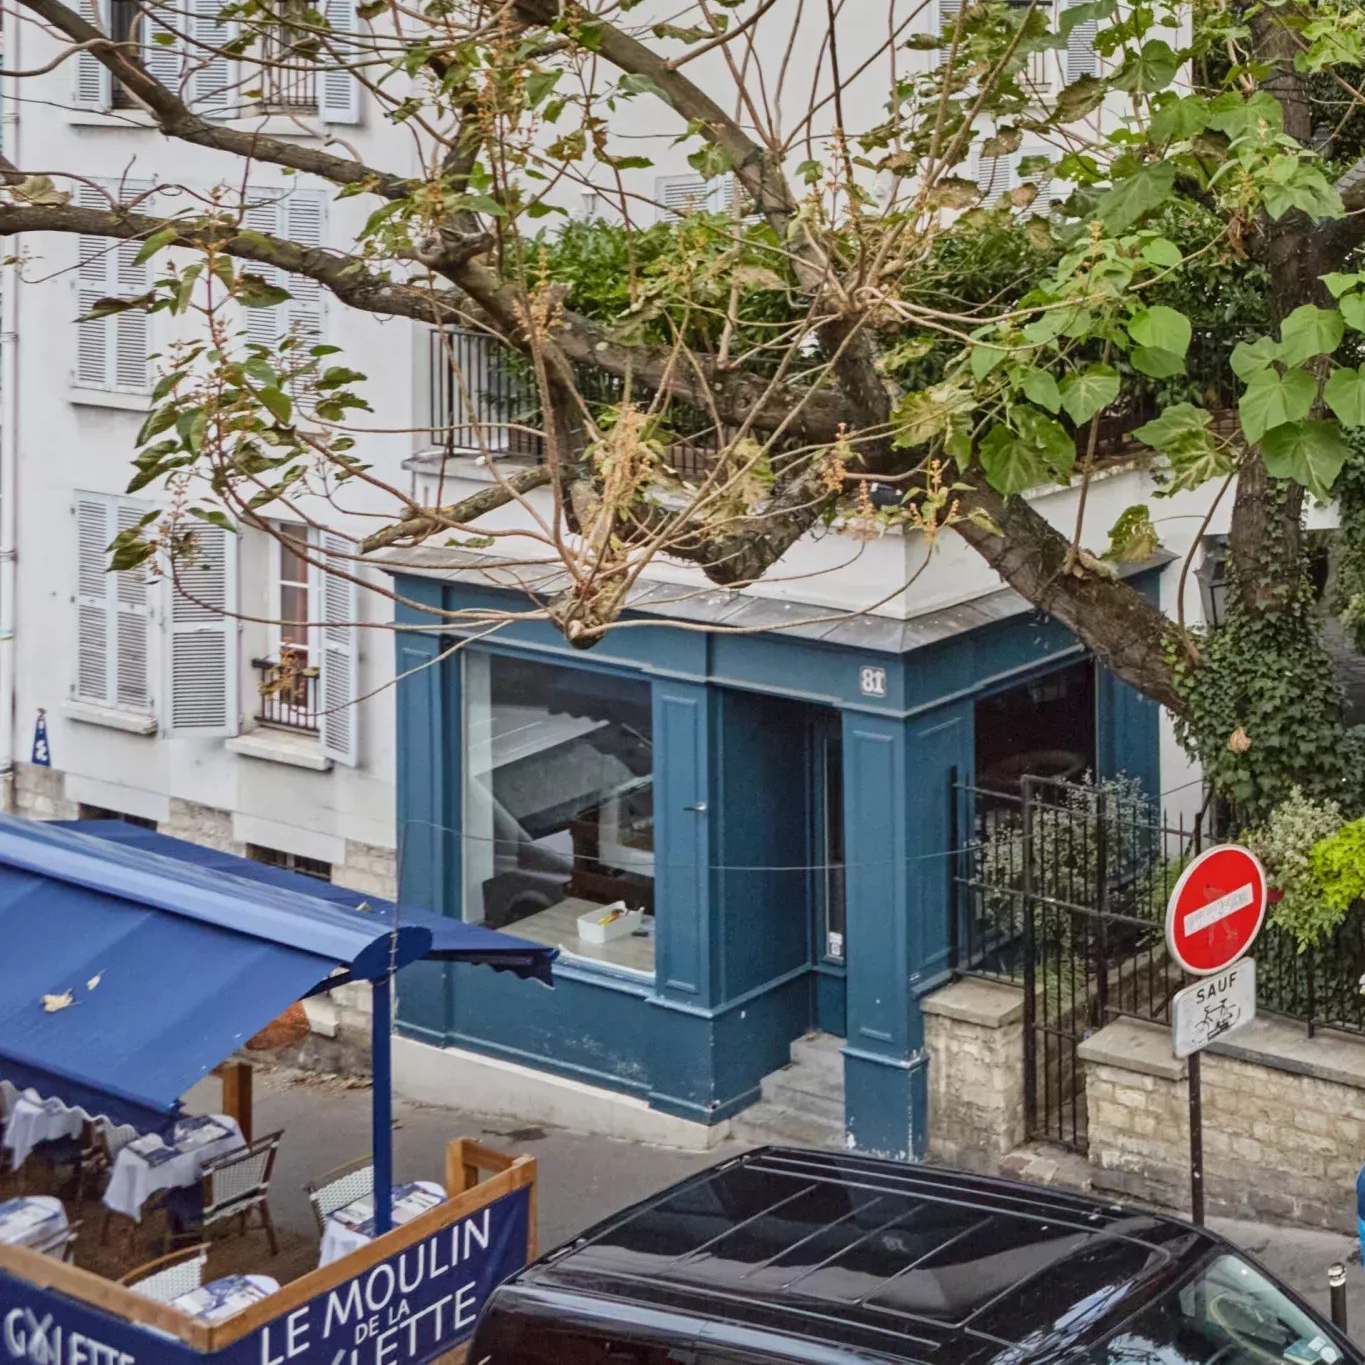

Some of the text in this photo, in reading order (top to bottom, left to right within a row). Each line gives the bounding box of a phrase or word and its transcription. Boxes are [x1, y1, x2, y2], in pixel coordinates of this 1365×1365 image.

[1196, 971, 1238, 1005] SAUF
[261, 1208, 491, 1365] LE MOULIN
[355, 1298, 411, 1345] DE LA
